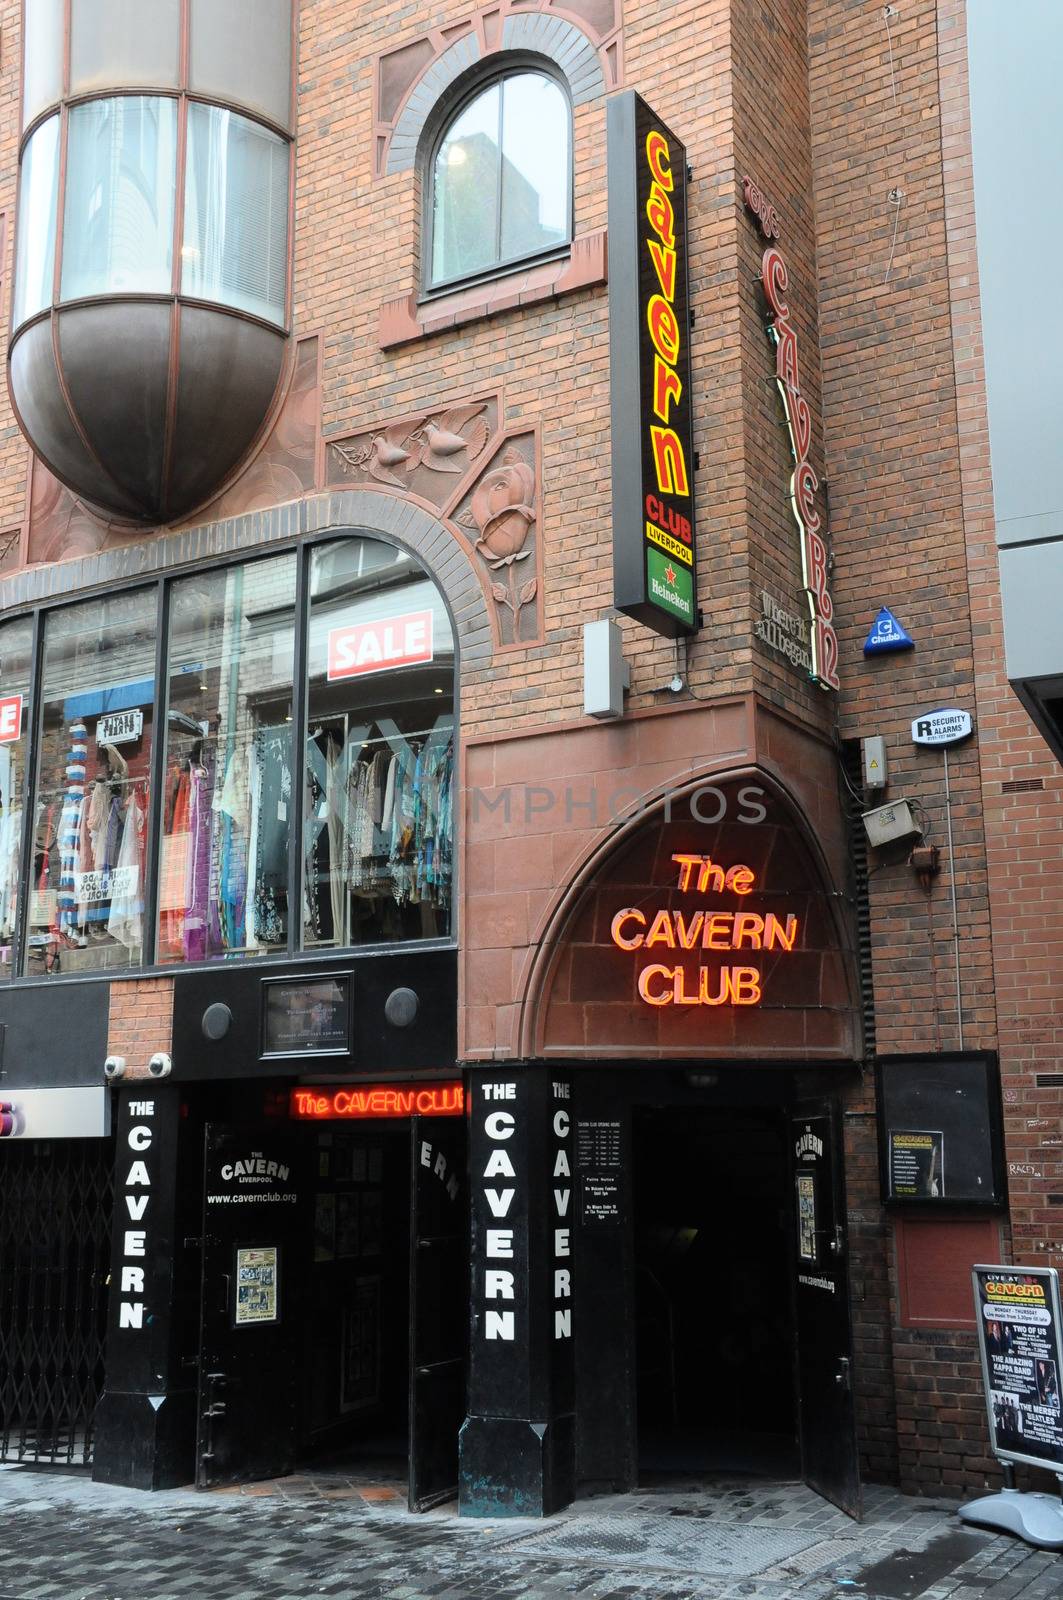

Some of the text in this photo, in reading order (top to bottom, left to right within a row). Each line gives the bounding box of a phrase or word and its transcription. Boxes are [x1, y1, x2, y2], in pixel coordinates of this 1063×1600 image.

[645, 130, 690, 498] cavern
[646, 494, 691, 544] CLUB
[649, 526, 690, 562] LIVERPOOL
[652, 578, 690, 613] Heineken
[335, 620, 426, 669] SALE
[871, 632, 900, 645] Chubb
[1, 704, 17, 734] E
[917, 715, 966, 737] R SECURITY
[934, 724, 962, 735] ALARMS
[671, 854, 755, 895] The
[610, 907, 798, 951] CAVERN
[638, 964, 761, 1006] CLUB
[295, 1089, 330, 1115] The
[334, 1091, 415, 1114] CAVERN
[481, 1083, 517, 1100] THE
[552, 1082, 570, 1099] THE
[128, 1101, 155, 1116] THE
[795, 1134, 823, 1158] CAVERN
[221, 1159, 290, 1181] CAVERN
[207, 1192, 297, 1204] www.cavernclub.org
[119, 1125, 153, 1329] CAVERN
[483, 1111, 516, 1341] CAVERN
[553, 1110, 571, 1340] CAVERN
[985, 1282, 1045, 1297] cavern
[1013, 1325, 1028, 1334] TWO
[1037, 1328, 1047, 1336] US
[991, 1354, 1034, 1368] THE AMAZING
[1014, 1365, 1032, 1376] BAND
[1020, 1402, 1061, 1418] THE MERSEY
[1026, 1412, 1055, 1426] BEATLES
